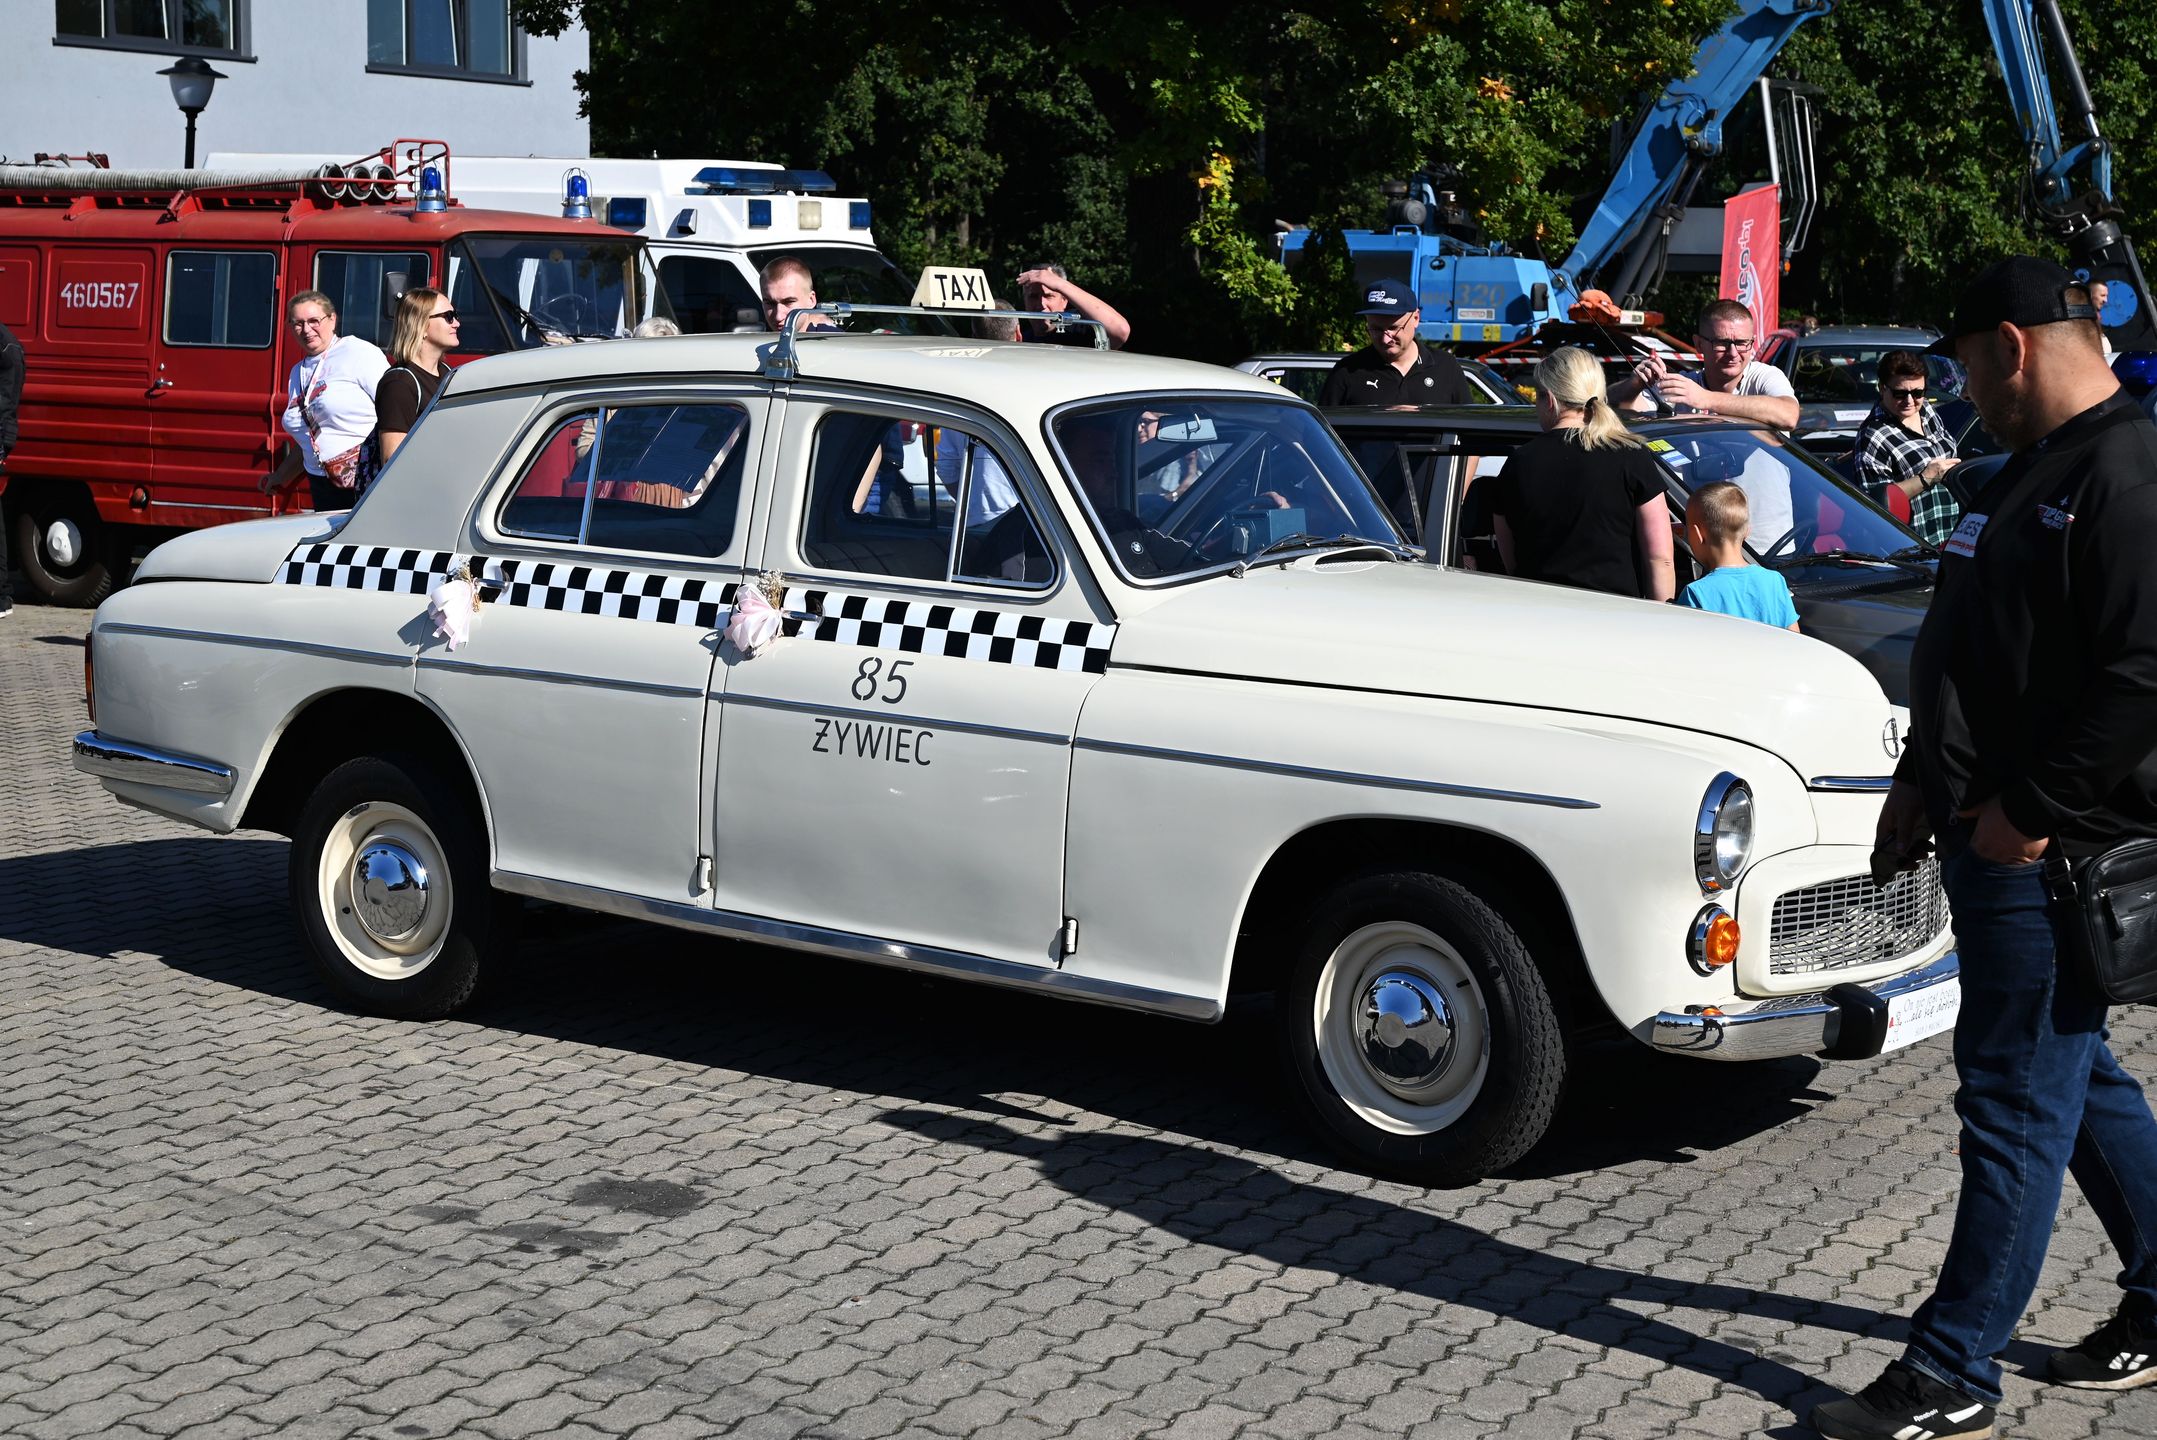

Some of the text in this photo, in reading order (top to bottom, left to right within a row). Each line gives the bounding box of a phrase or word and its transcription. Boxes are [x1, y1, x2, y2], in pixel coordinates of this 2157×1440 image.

[61, 283, 139, 308] 460567
[934, 274, 986, 301] TAXI
[1456, 283, 1505, 307] 320
[851, 657, 914, 704] 85
